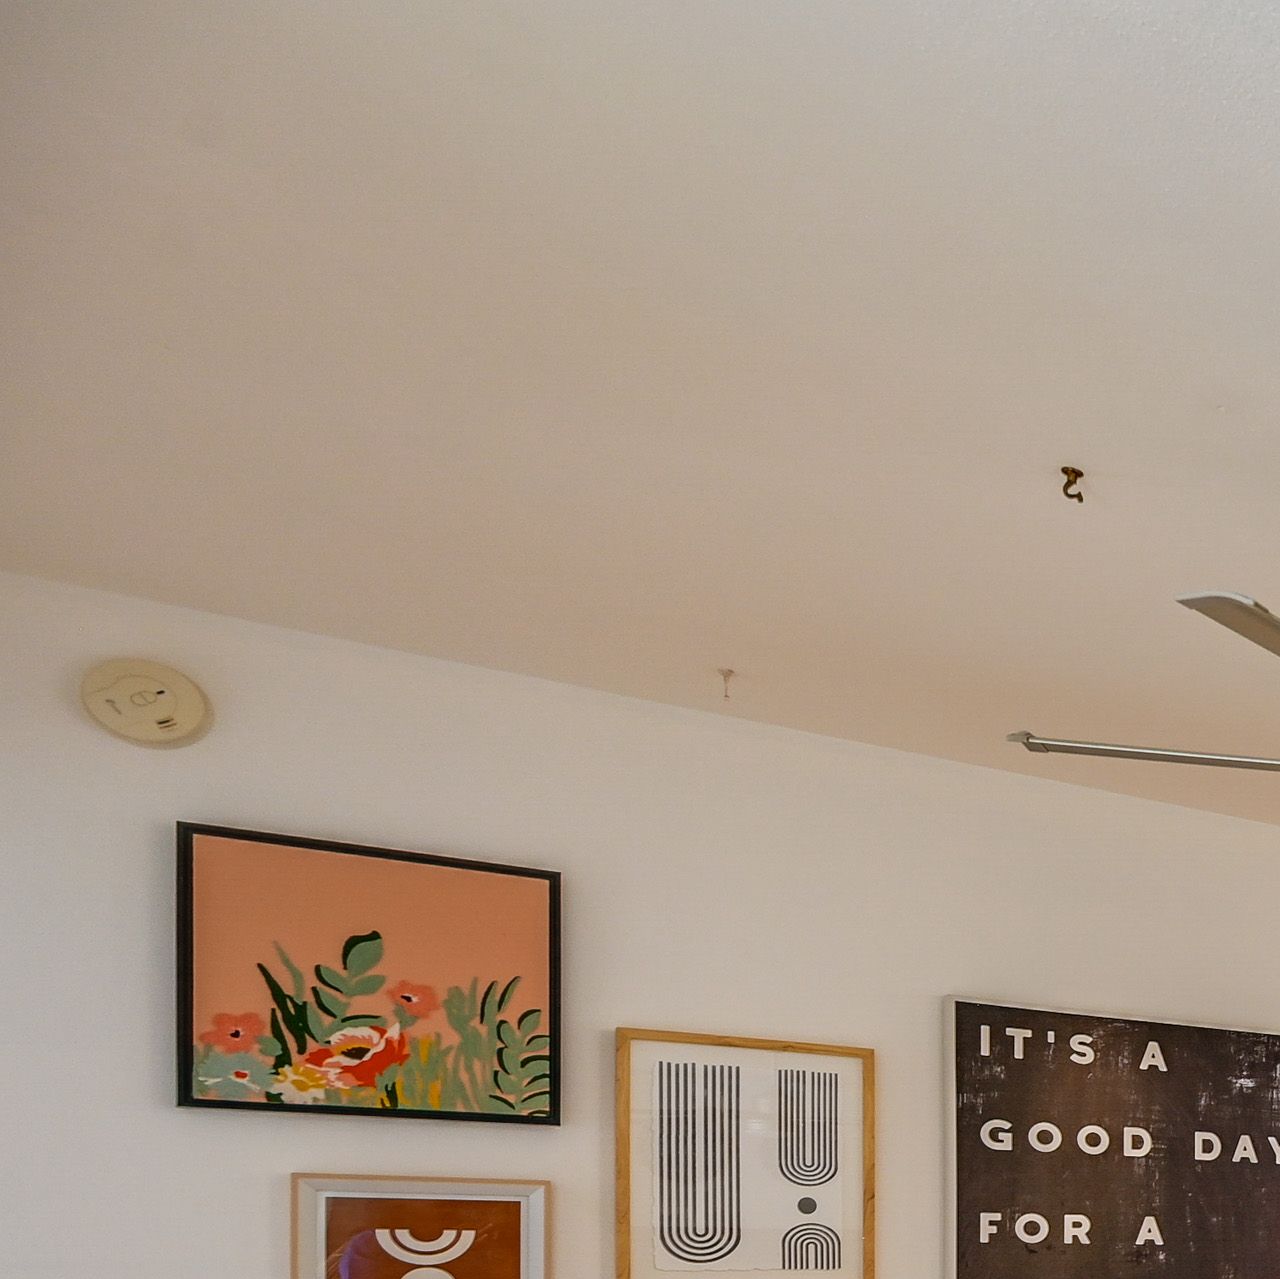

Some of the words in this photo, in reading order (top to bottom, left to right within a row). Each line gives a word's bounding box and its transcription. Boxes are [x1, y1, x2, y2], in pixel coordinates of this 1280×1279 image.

[980, 1024, 1095, 1065] IT'S
[1139, 1041, 1168, 1072] A
[979, 1119, 1153, 1158] GOOD
[979, 1212, 1091, 1245] FOR
[1135, 1216, 1164, 1246] A
